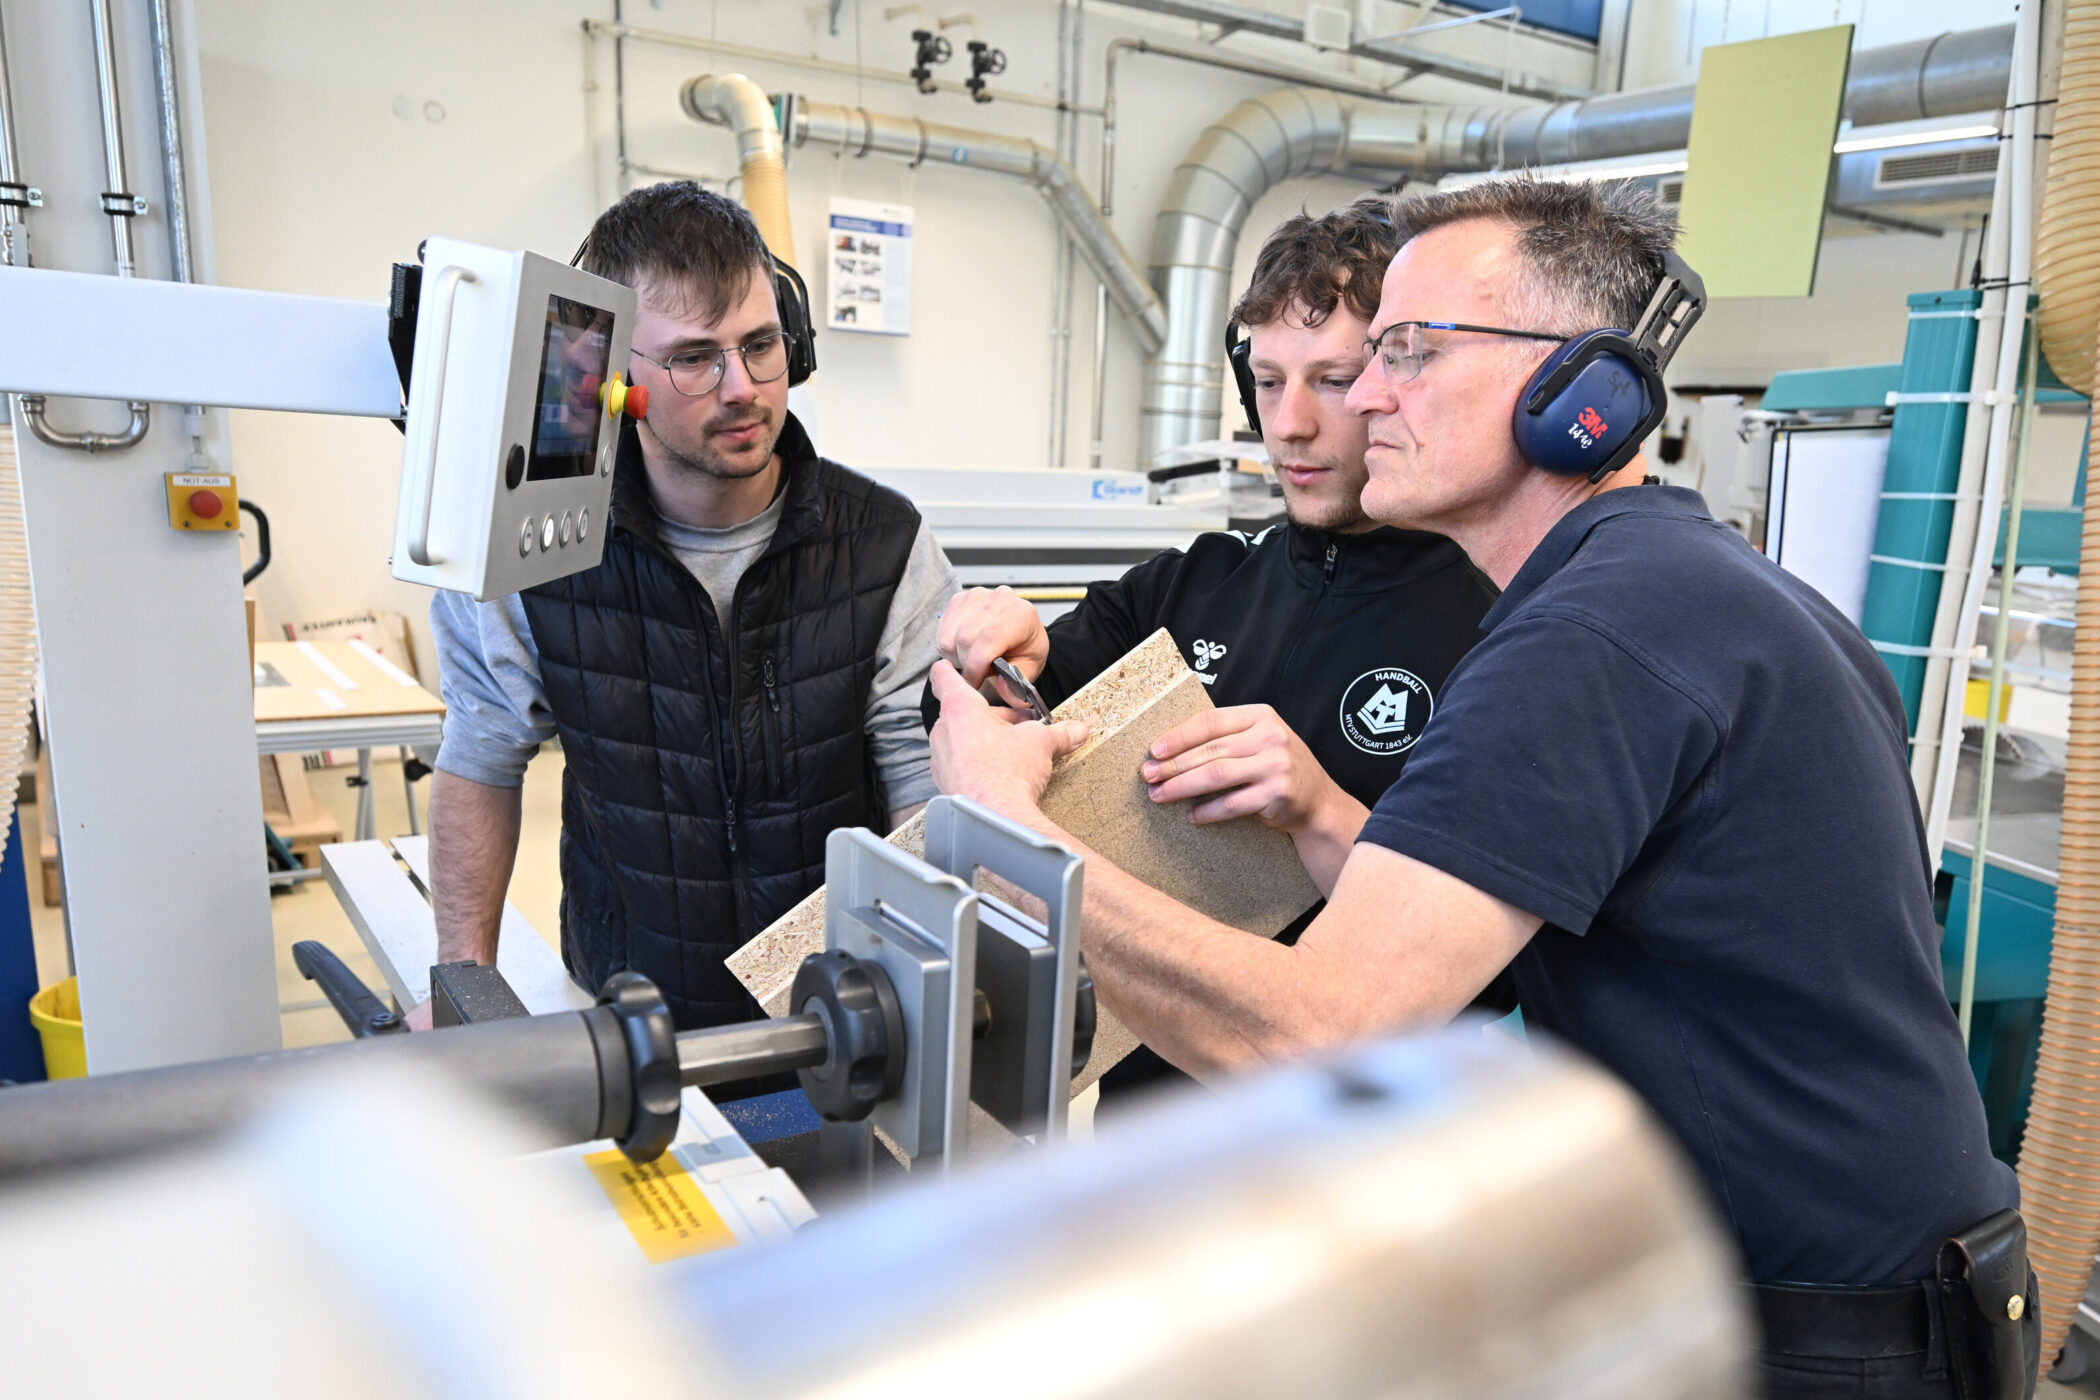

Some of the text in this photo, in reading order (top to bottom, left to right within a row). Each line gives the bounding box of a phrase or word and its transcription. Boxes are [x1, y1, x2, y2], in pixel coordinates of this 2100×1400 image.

[1578, 406, 1609, 439] 3M
[1375, 672, 1422, 694] HANDBALL
[1349, 728, 1384, 749] STUTTGART
[1386, 740, 1402, 749] 1843
